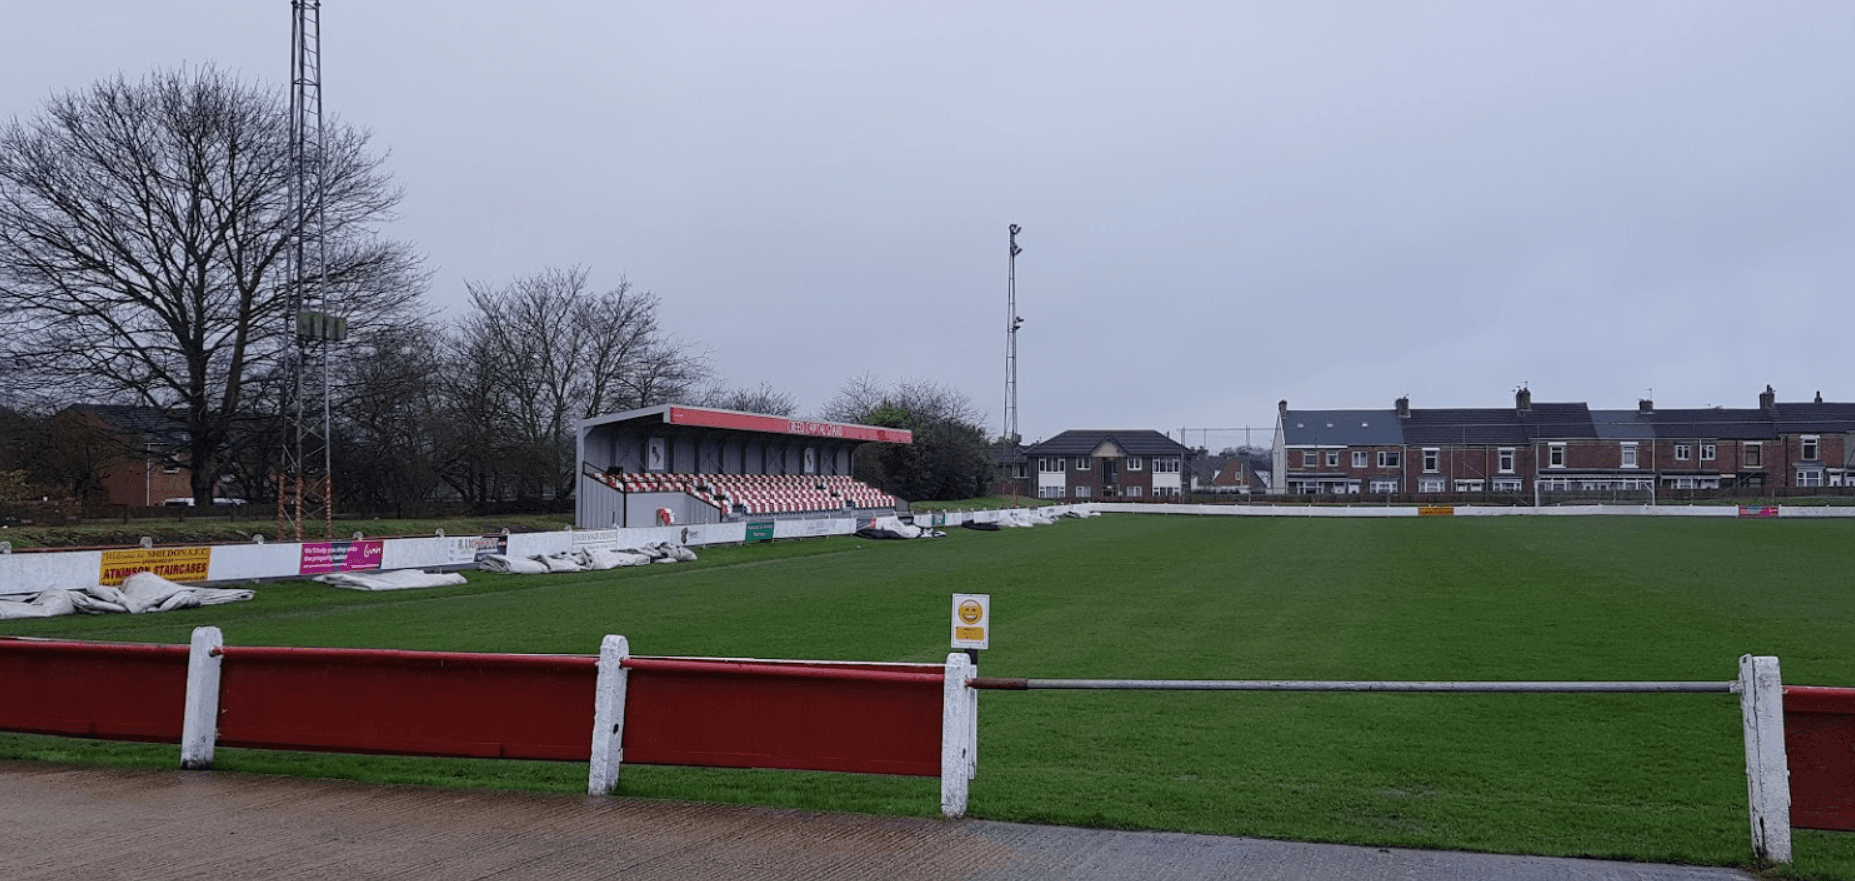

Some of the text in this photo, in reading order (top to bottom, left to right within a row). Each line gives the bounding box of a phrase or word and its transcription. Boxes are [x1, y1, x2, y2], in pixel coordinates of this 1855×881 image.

[147, 548, 186, 558] SHILDON
[103, 564, 151, 580] ATKINSON
[153, 562, 206, 576] STAIRCASES
